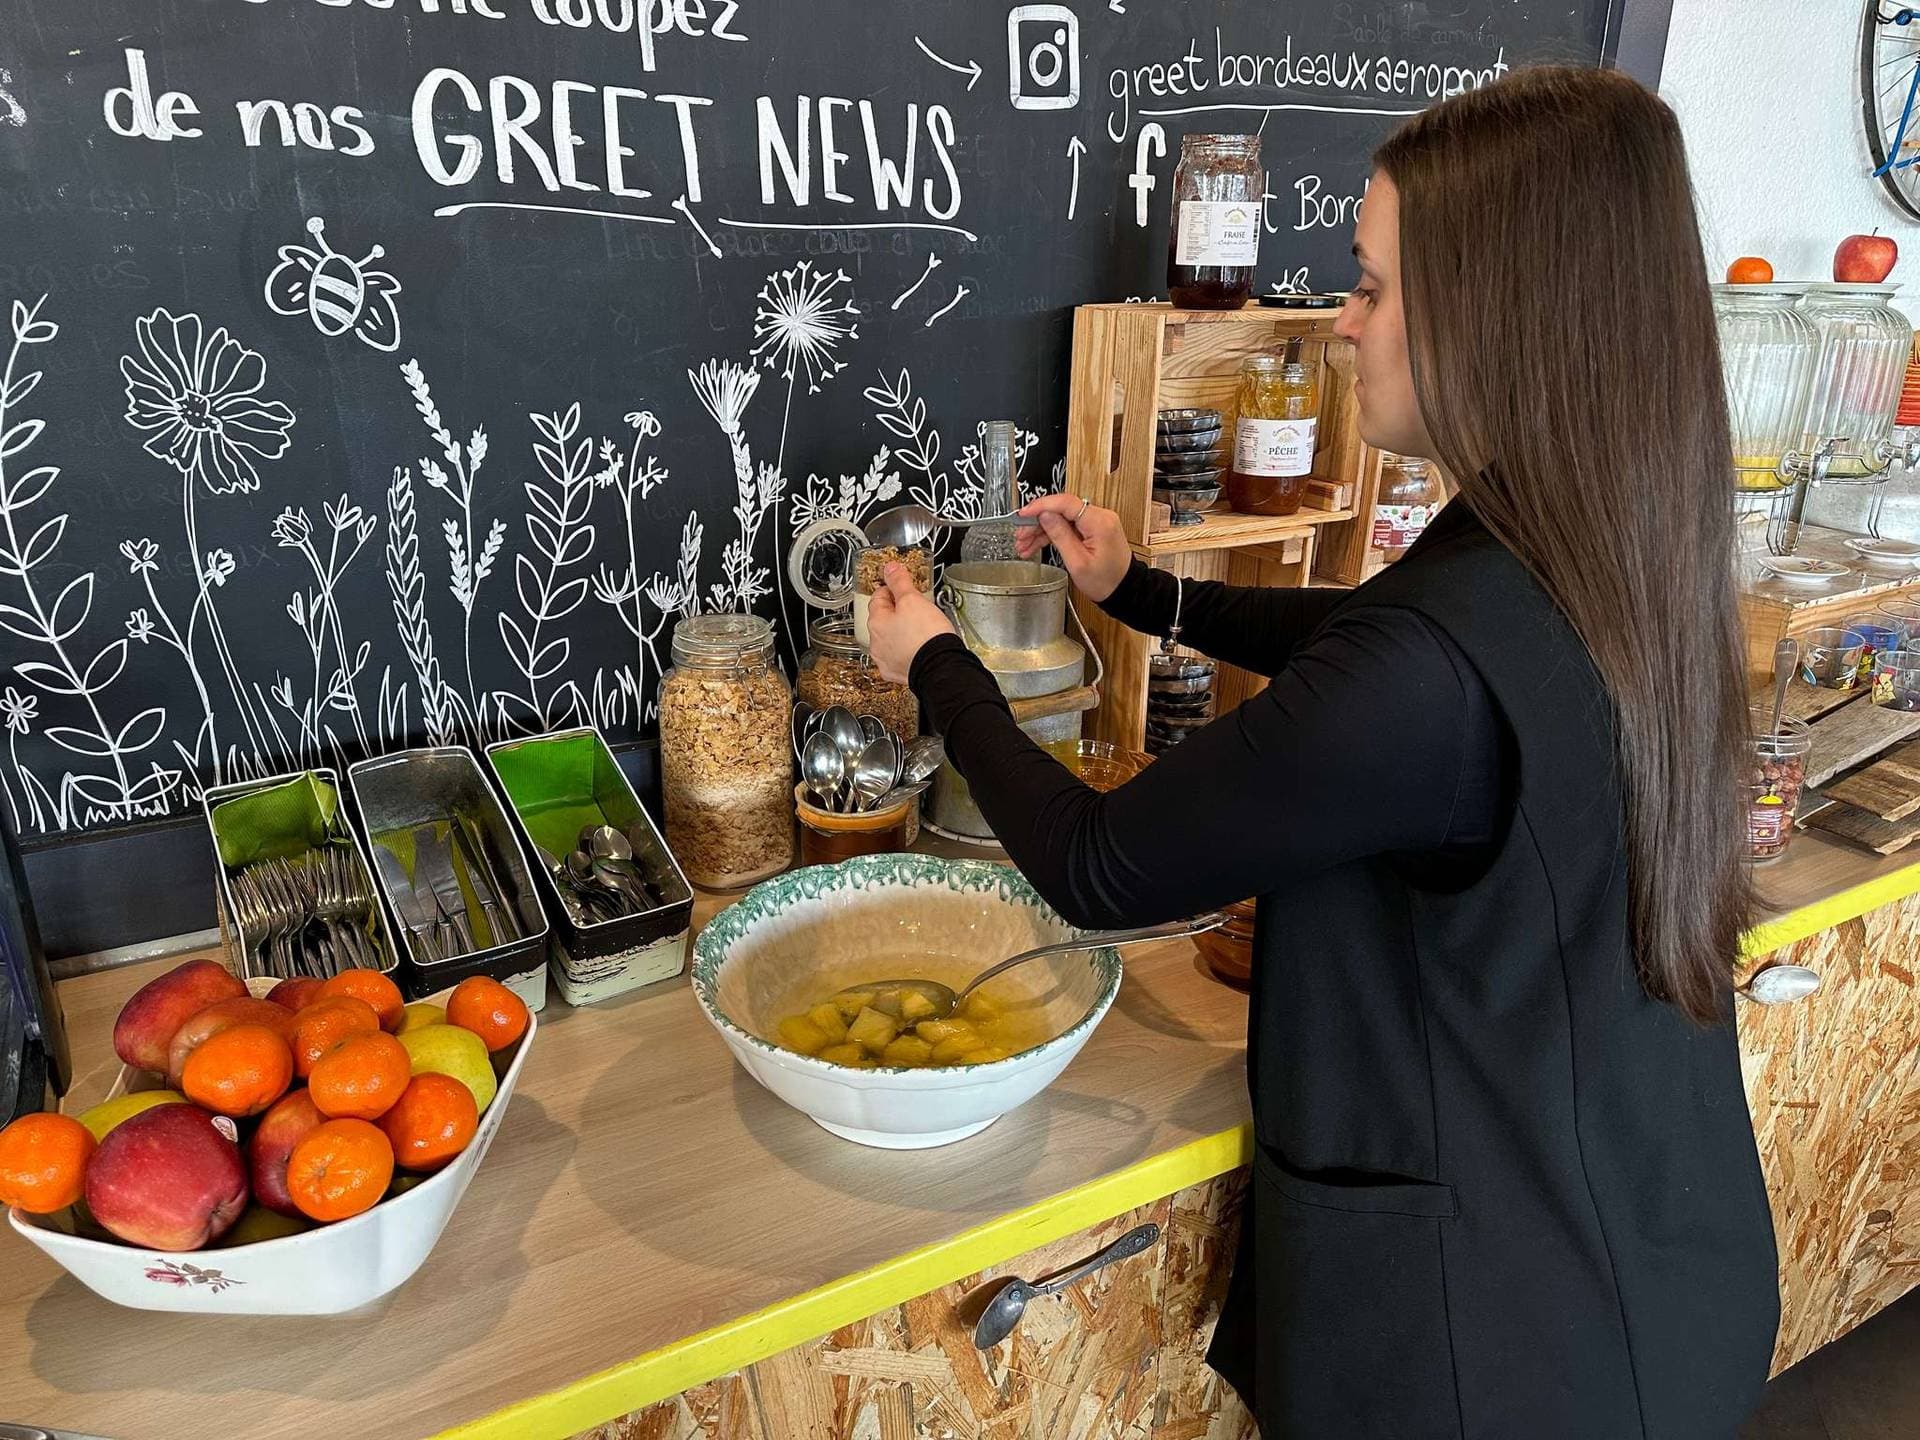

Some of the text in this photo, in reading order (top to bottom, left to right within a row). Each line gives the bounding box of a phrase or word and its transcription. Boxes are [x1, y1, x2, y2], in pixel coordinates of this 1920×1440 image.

[104, 48, 203, 141] de
[236, 100, 375, 156] nos
[412, 68, 713, 202] GREET
[757, 95, 961, 220] NEWS
[1108, 39, 1209, 142] greet
[1217, 27, 1370, 90] bordeaux
[1268, 446, 1298, 456] PÊCHE
